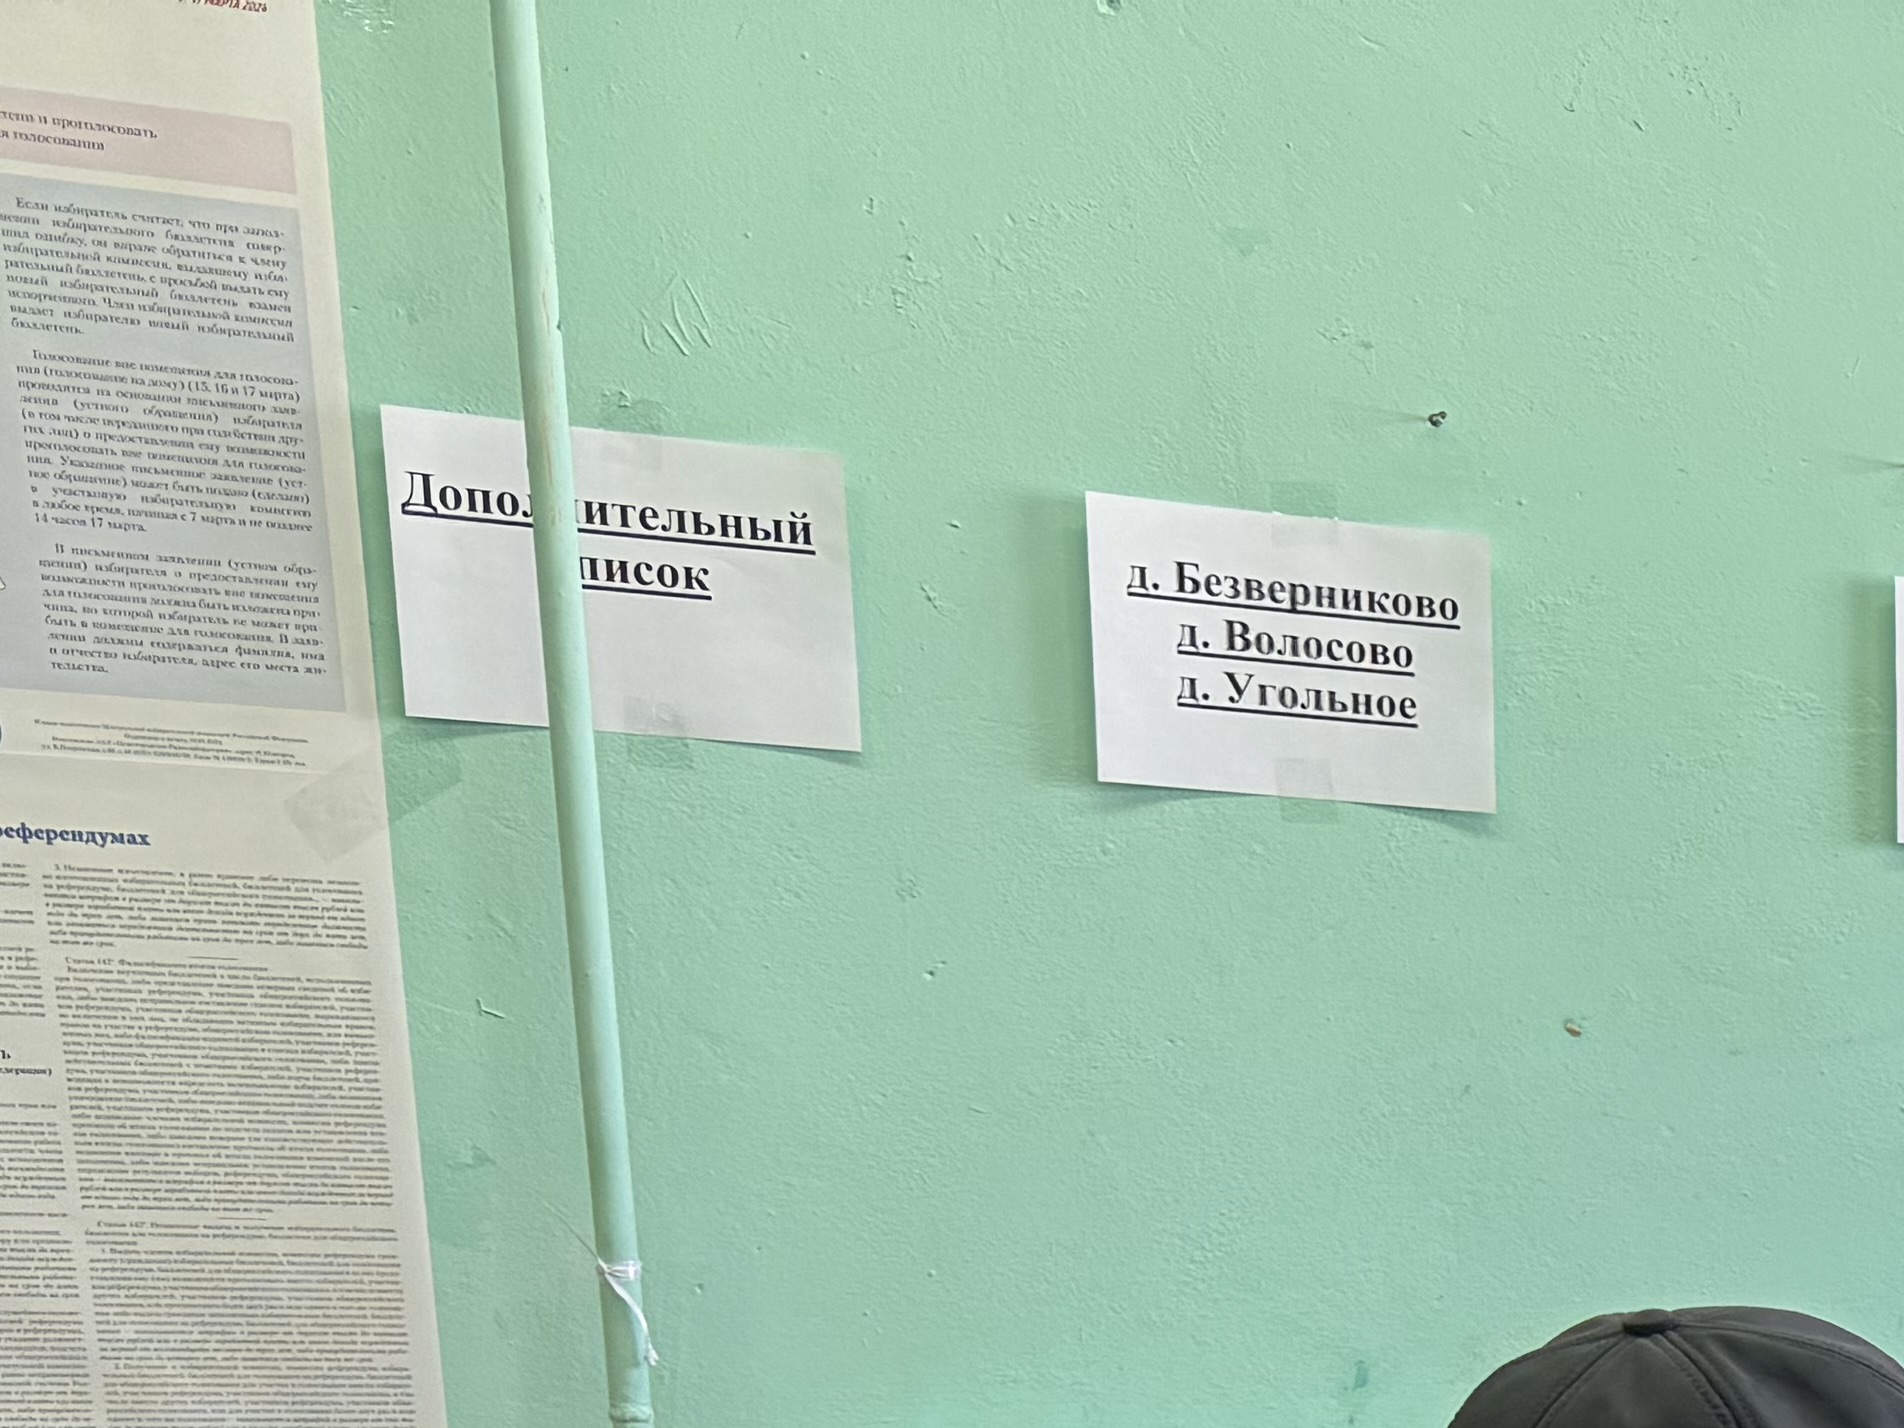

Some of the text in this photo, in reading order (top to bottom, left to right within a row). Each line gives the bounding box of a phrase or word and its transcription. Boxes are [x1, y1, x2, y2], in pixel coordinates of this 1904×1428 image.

[402, 472, 814, 546] Допоительный
[580, 556, 711, 592] писок
[1127, 561, 1460, 622] д. Безверниково
[1177, 619, 1414, 669] д. Волосово
[1177, 671, 1418, 719] д. Угольное
[0, 822, 152, 848] еферендумах
